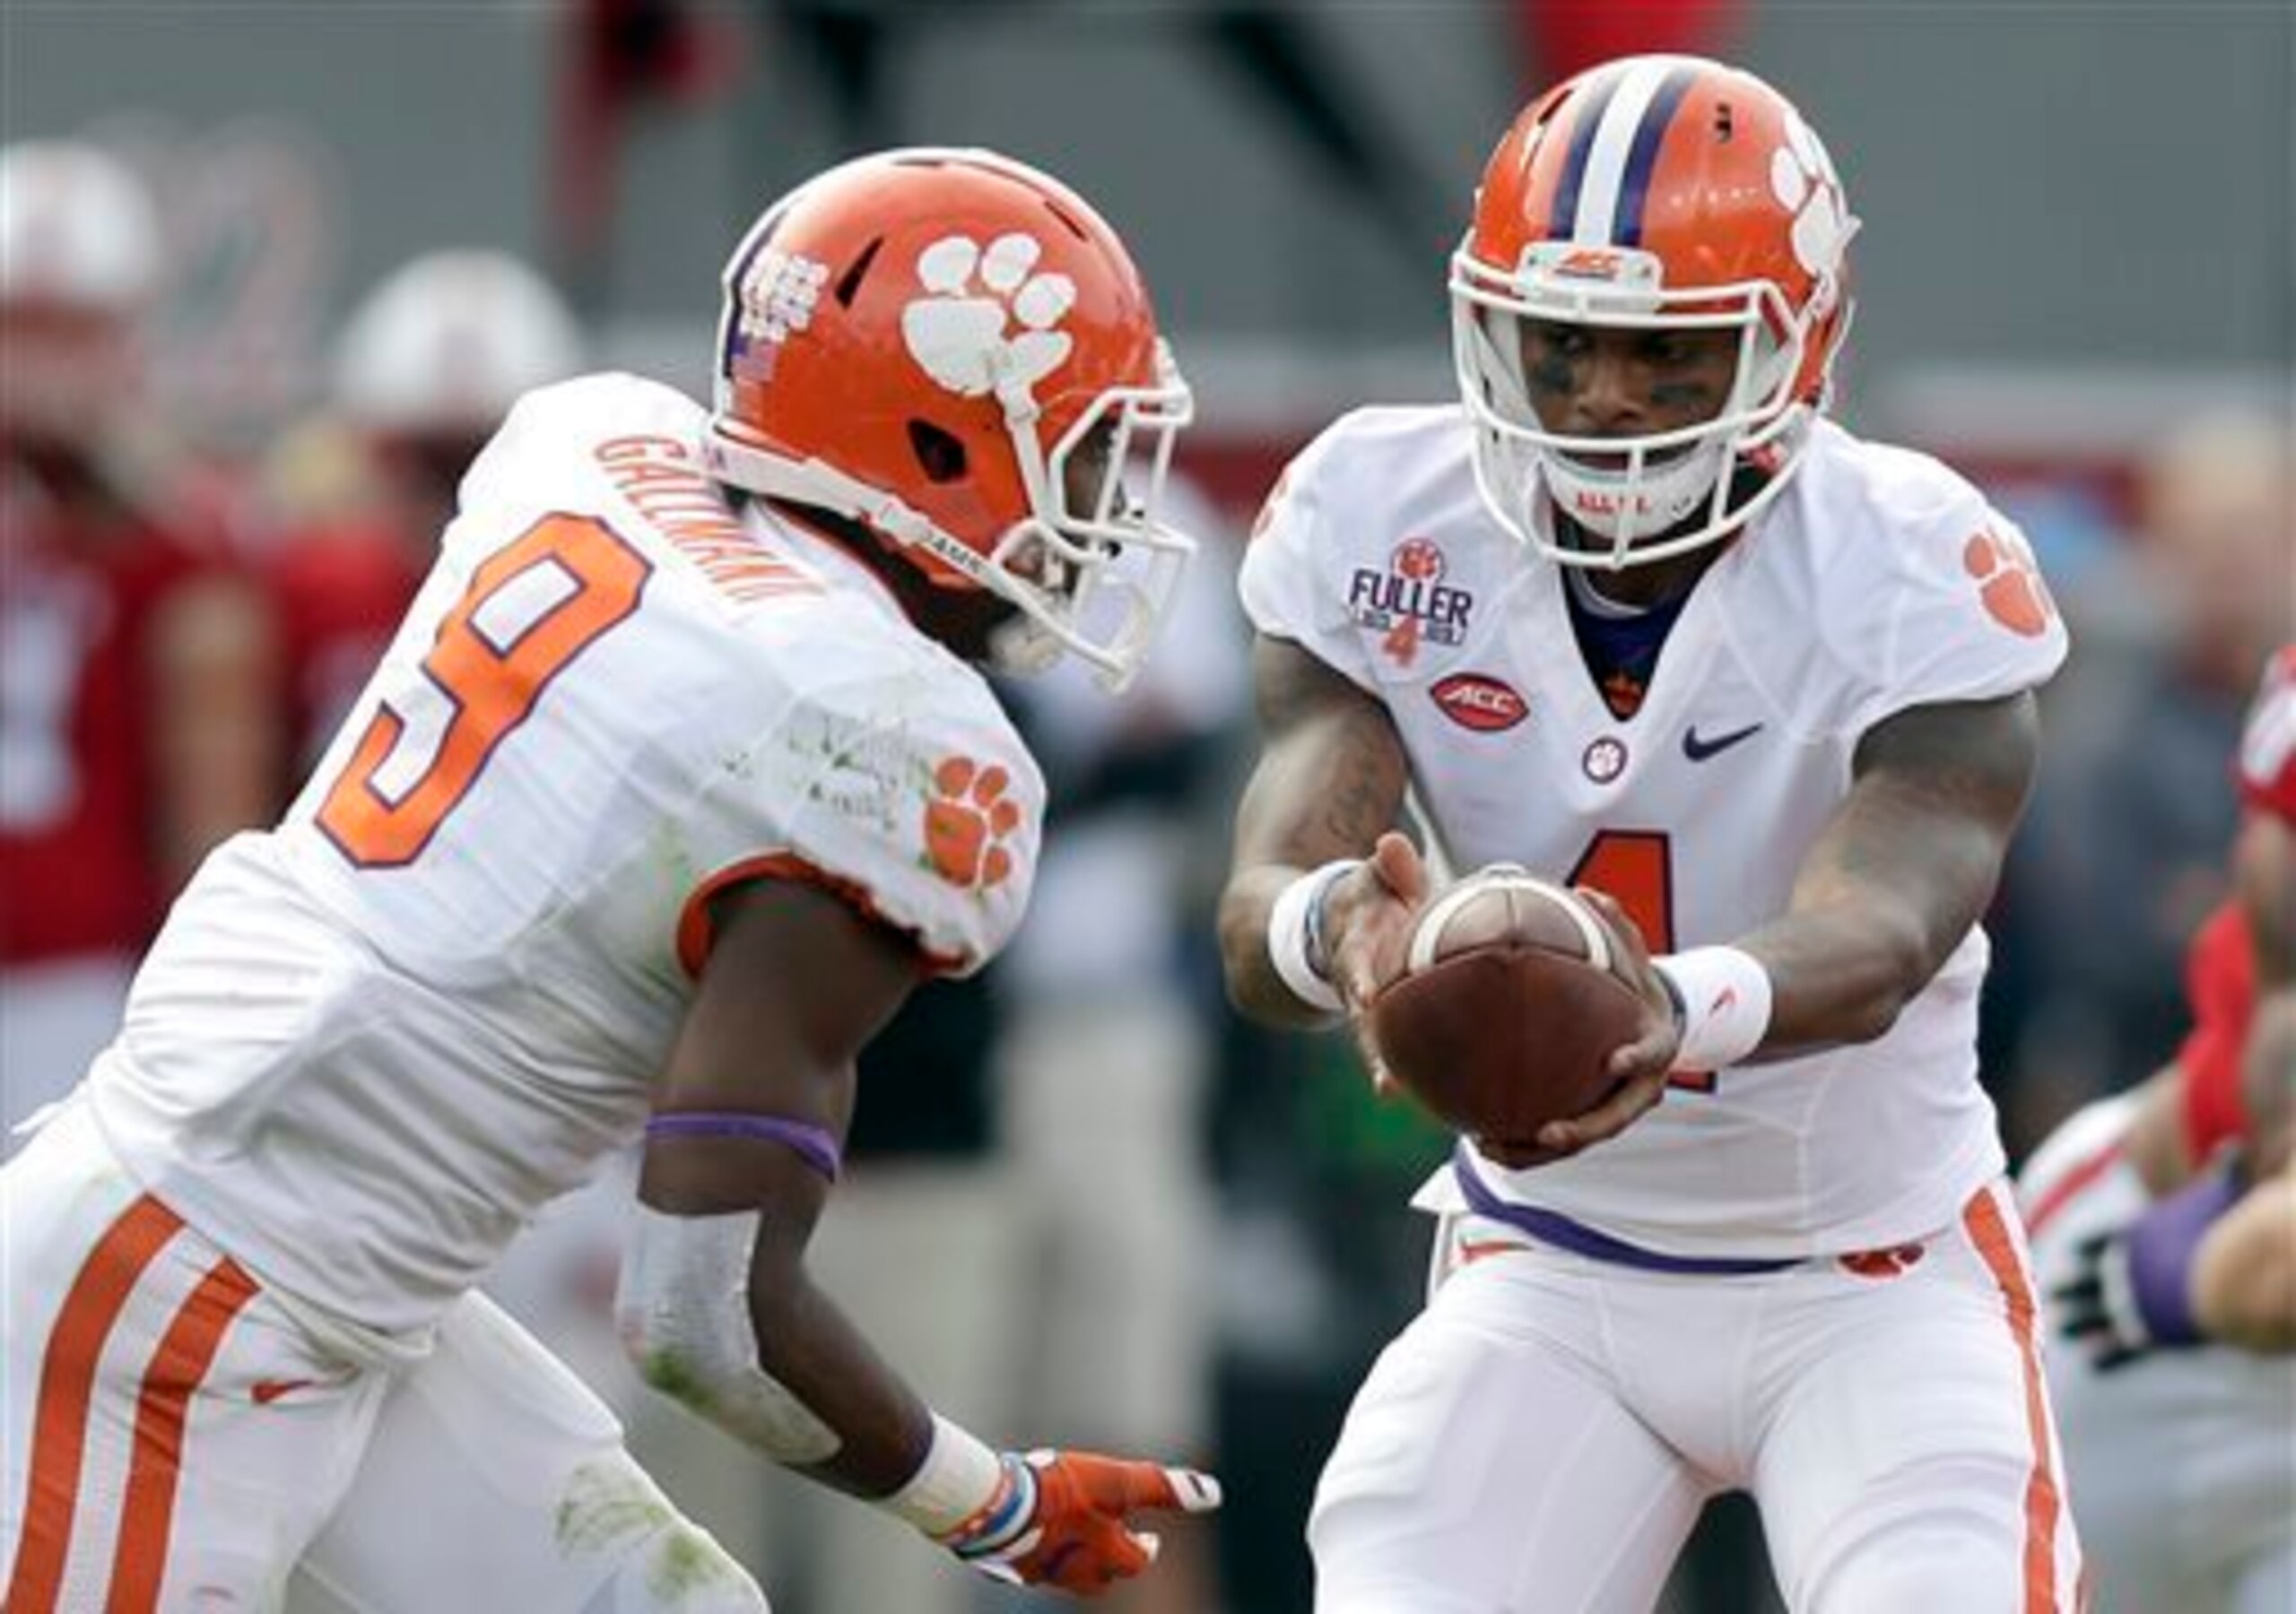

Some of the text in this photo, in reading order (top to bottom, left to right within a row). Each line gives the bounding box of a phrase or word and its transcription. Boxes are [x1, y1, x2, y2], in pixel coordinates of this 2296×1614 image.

[1349, 568, 1473, 629] FULLER
[313, 511, 656, 870] 9
[1442, 683, 1518, 716] ACC
